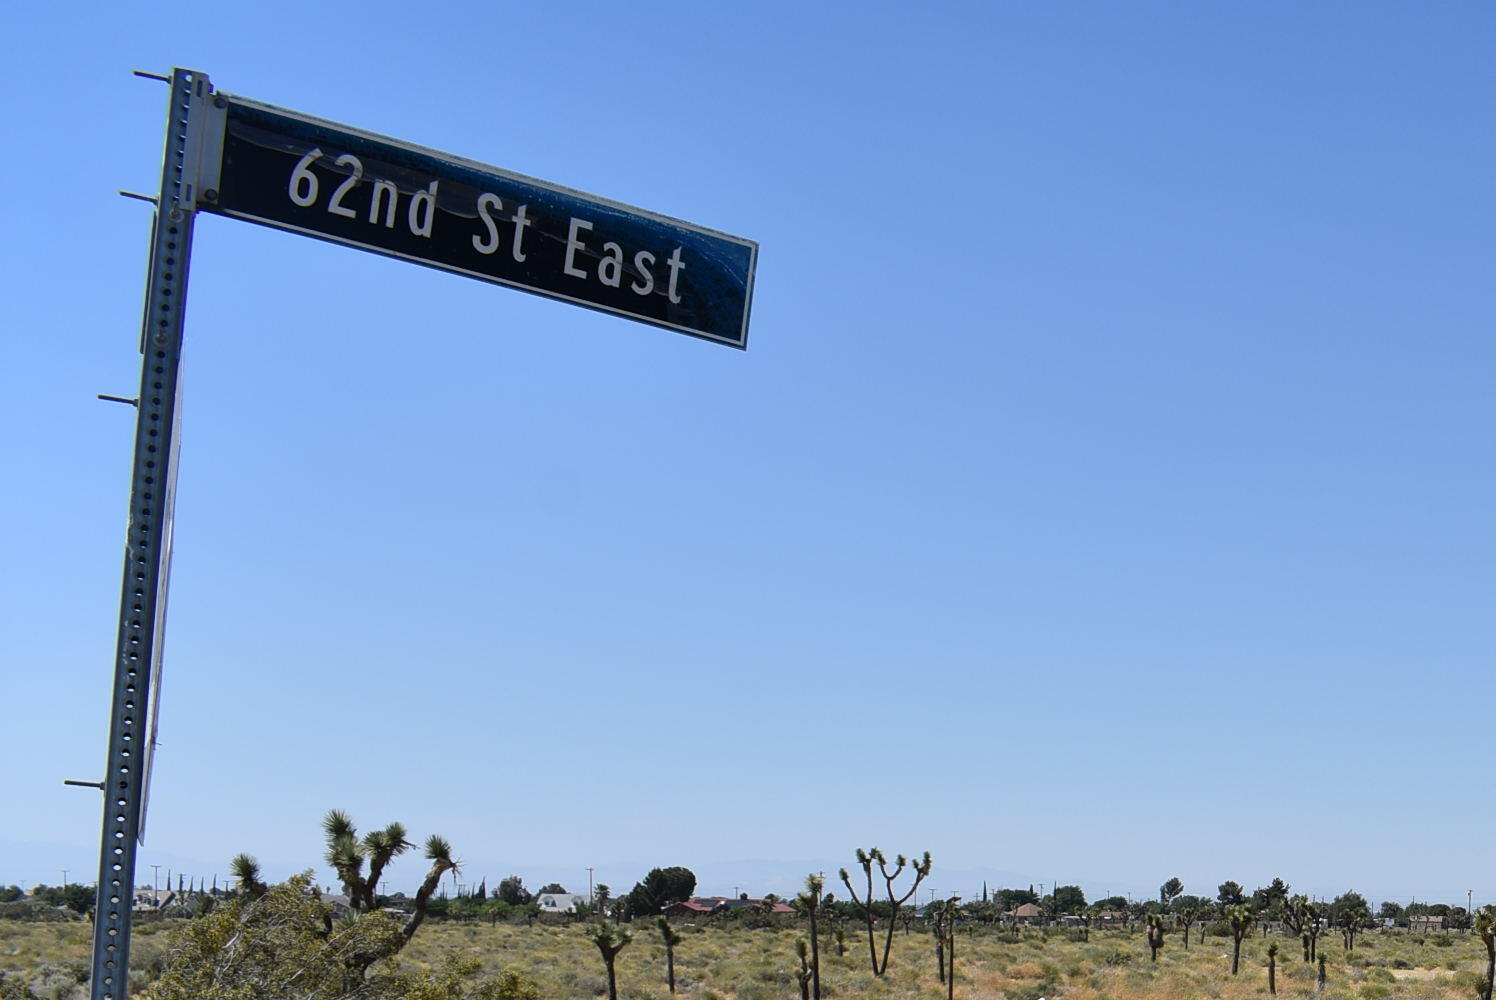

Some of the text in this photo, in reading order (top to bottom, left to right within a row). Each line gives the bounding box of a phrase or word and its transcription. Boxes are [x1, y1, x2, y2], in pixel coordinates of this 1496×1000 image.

[289, 148, 686, 304] 62nd St East
